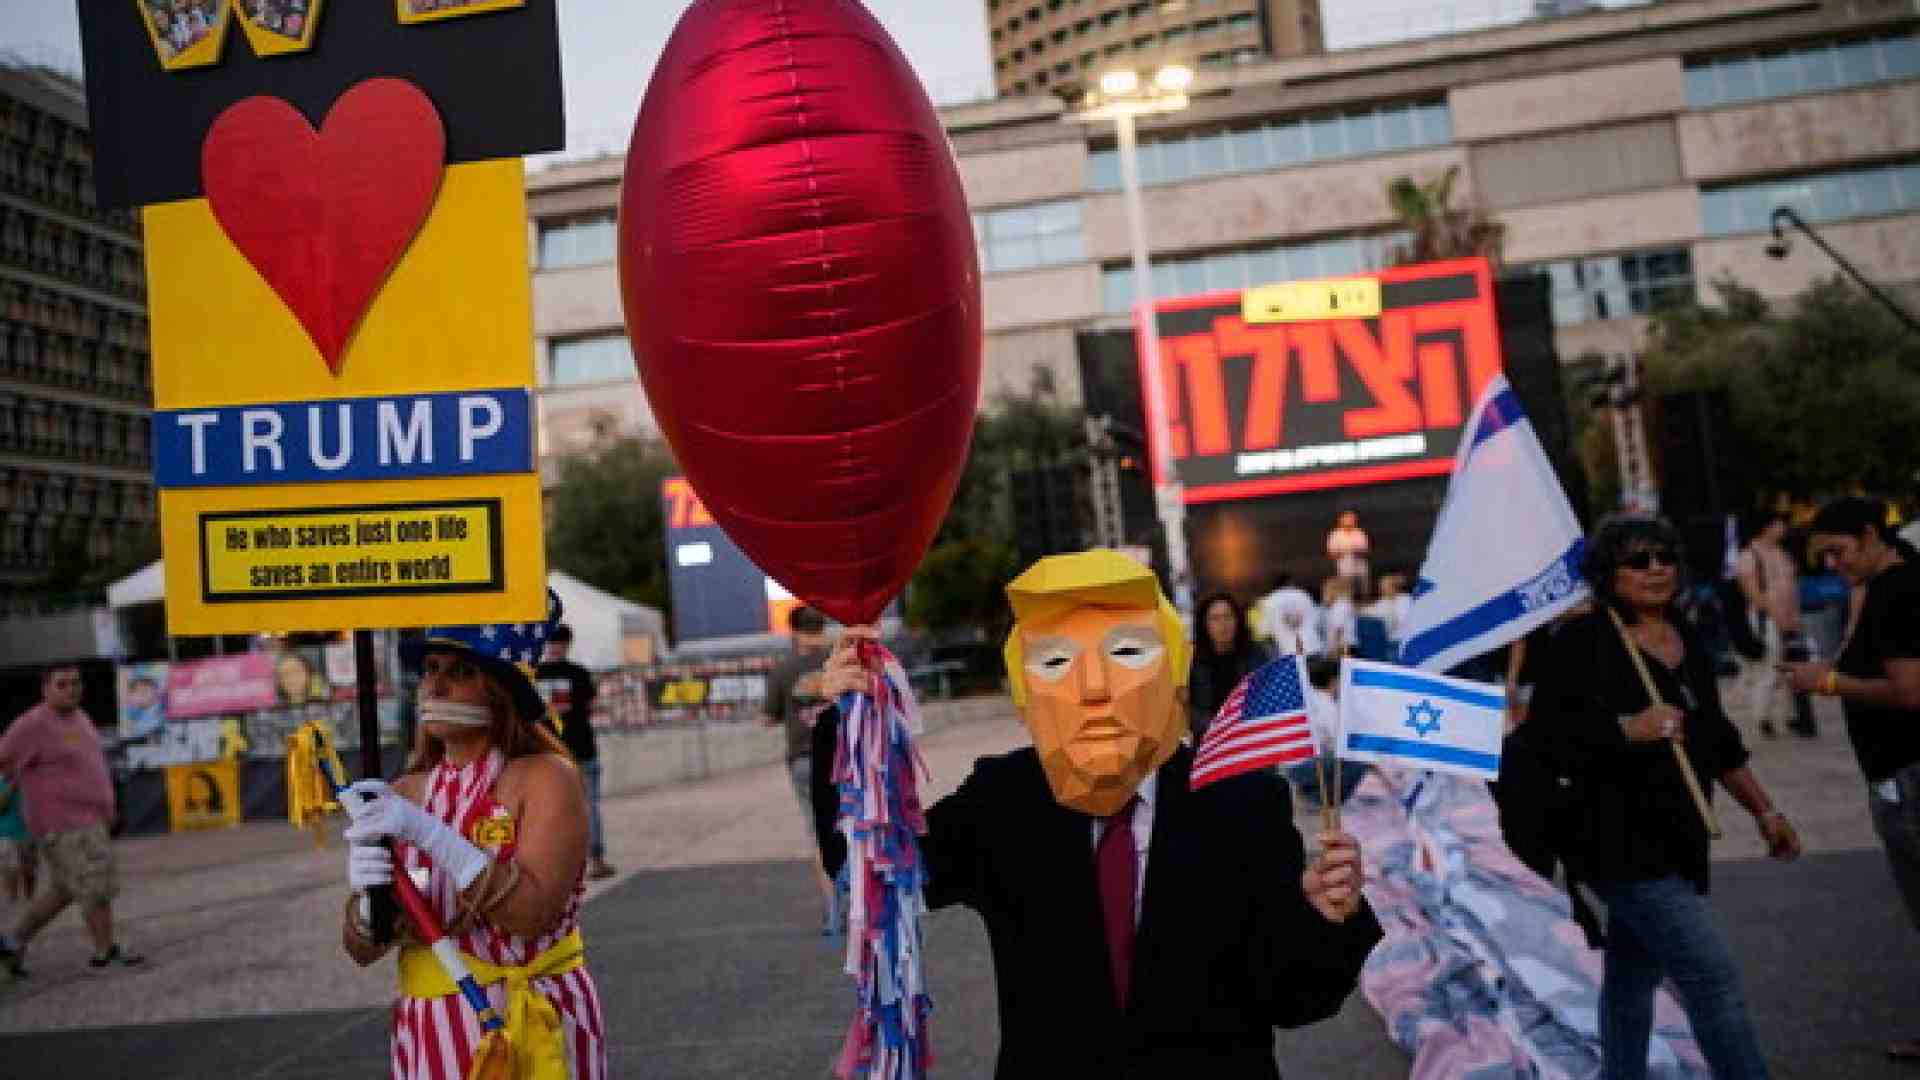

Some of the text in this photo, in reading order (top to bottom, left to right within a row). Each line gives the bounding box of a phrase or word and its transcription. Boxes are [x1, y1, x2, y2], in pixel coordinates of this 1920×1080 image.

[177, 395, 504, 475] TRUMP
[225, 514, 467, 551] He who saves just one life
[249, 554, 451, 587] saves an entire world
